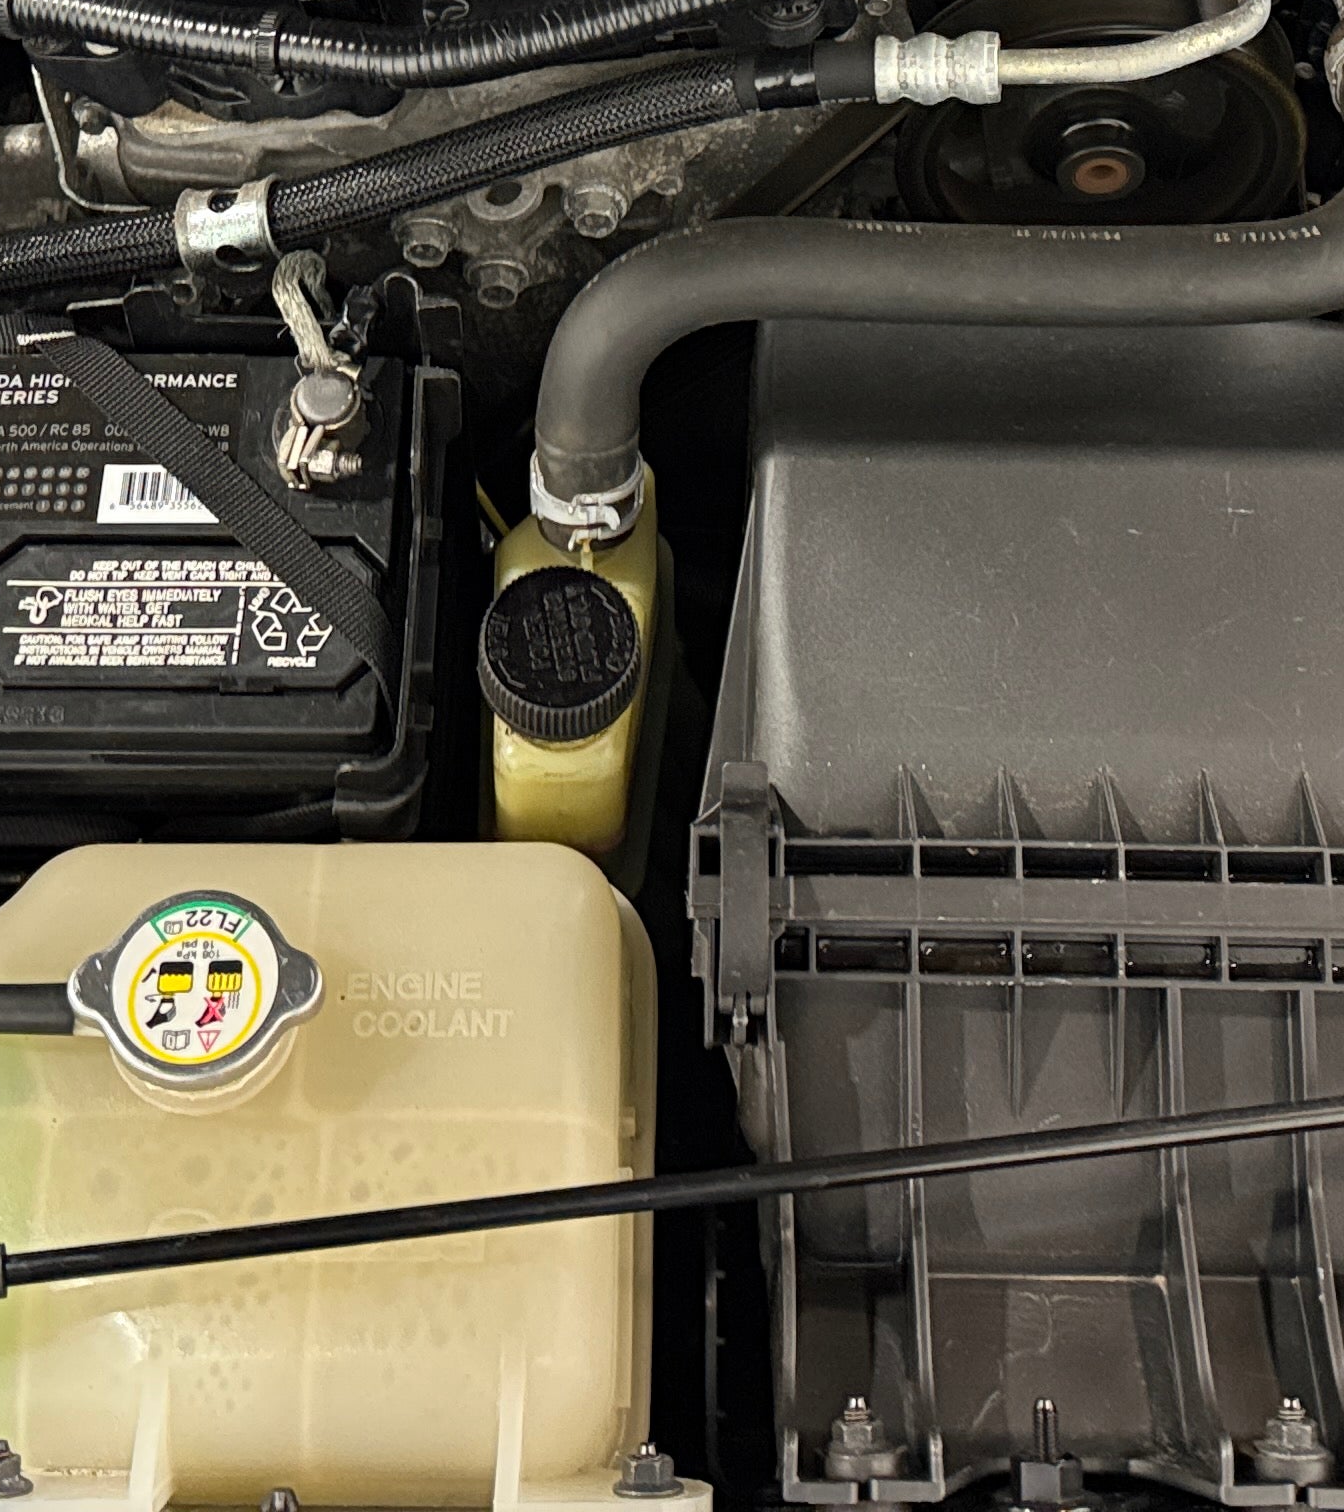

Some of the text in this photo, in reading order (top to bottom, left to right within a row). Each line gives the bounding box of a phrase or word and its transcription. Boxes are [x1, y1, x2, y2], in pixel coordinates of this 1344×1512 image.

[8, 424, 38, 438] 500
[50, 424, 69, 437] RC
[72, 424, 91, 436] 85
[21, 441, 69, 452] America
[71, 440, 134, 453] Operations
[92, 560, 120, 571] KEEP
[120, 560, 143, 571] OUT
[144, 560, 160, 571] OF
[161, 560, 182, 571] THE
[183, 560, 217, 571] REACH
[218, 560, 234, 571] OF
[69, 570, 86, 581] DO
[87, 570, 112, 581] NOT
[133, 570, 160, 581] KEEP
[161, 570, 189, 581] VENT
[189, 570, 217, 581] CAPS
[219, 570, 248, 581] TIGHT
[250, 570, 272, 581] AND
[64, 589, 222, 602] FLUSH EYES IMMEDIATELY
[63, 602, 95, 615] WITH
[145, 602, 171, 615] GET
[60, 614, 184, 627] MEDICAL HELP FAST
[266, 656, 317, 668] RECYCLE
[185, 909, 243, 935] FL22
[181, 939, 198, 950] psi
[176, 949, 197, 960] kPa
[346, 971, 484, 1001] ENGINE
[353, 1007, 514, 1038] COOLANT
